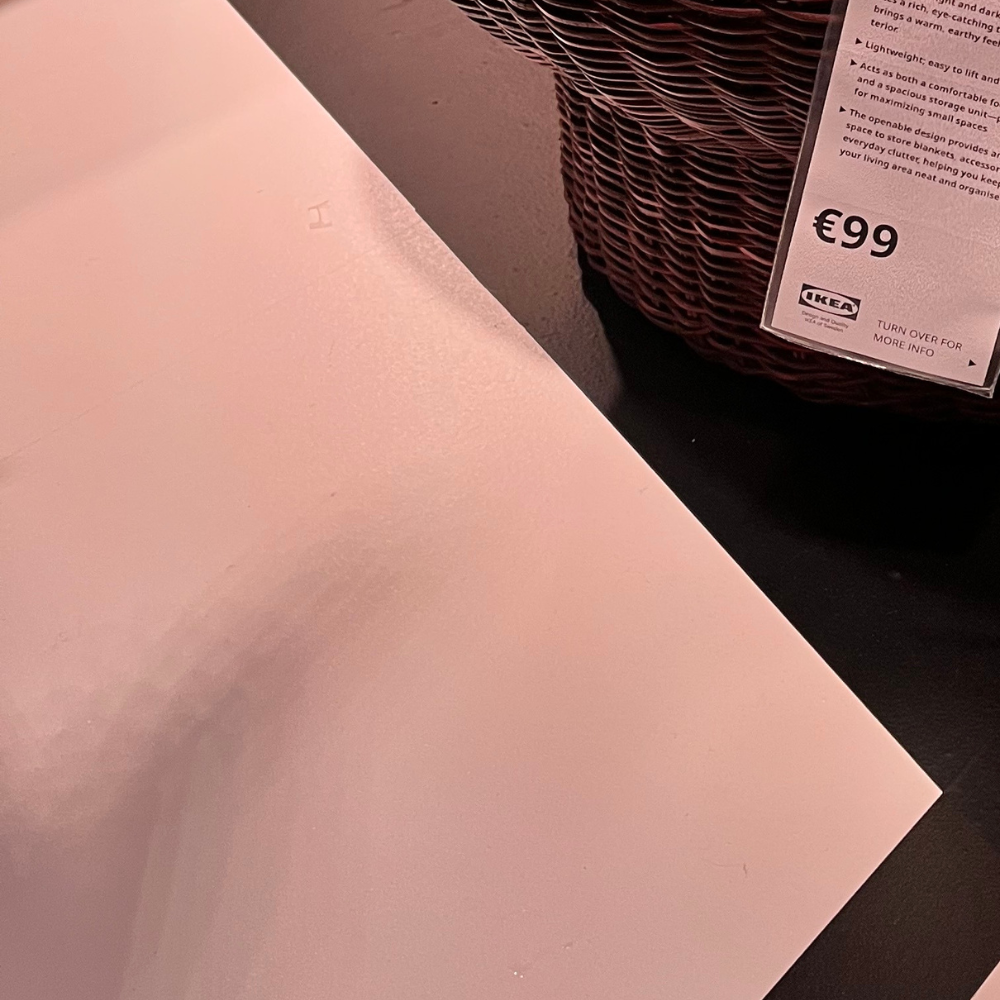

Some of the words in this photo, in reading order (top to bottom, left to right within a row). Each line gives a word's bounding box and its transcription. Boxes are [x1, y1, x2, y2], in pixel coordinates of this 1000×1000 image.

[873, 4, 905, 21] brings
[947, 28, 981, 43] earthy
[899, 0, 906, 7] a
[931, 8, 994, 33] eye-catching
[957, 1, 978, 12] and
[859, 62, 881, 75] Acts
[882, 69, 894, 78] as
[895, 71, 919, 85] both
[920, 80, 927, 88] a
[928, 82, 988, 105] comfortable
[928, 60, 951, 73] easy
[952, 66, 963, 75] to
[964, 68, 979, 80] lift
[981, 74, 1000, 85] and
[854, 87, 869, 98] for
[869, 94, 926, 116] maximizing
[927, 110, 954, 123] small
[856, 76, 876, 87] and
[885, 84, 927, 102] spacious
[928, 96, 966, 113] storage
[845, 122, 873, 136] space
[874, 130, 885, 139] to
[887, 134, 912, 147] store
[849, 108, 867, 120] The
[868, 115, 913, 134] openable
[914, 128, 946, 143] design
[947, 138, 989, 156] provides
[839, 148, 862, 160] your
[863, 153, 890, 170] living
[891, 163, 913, 175] area
[914, 171, 937, 182] neat
[938, 178, 957, 188] and
[842, 135, 886, 155] everyday
[922, 157, 959, 177] helping
[960, 170, 979, 181] you
[812, 208, 899, 258] €99
[806, 291, 853, 313] IKEA
[873, 332, 906, 350] MORE
[907, 342, 935, 358] INFO
[877, 319, 907, 336] TURN
[909, 329, 939, 345] OVER
[940, 338, 963, 352] FOR
